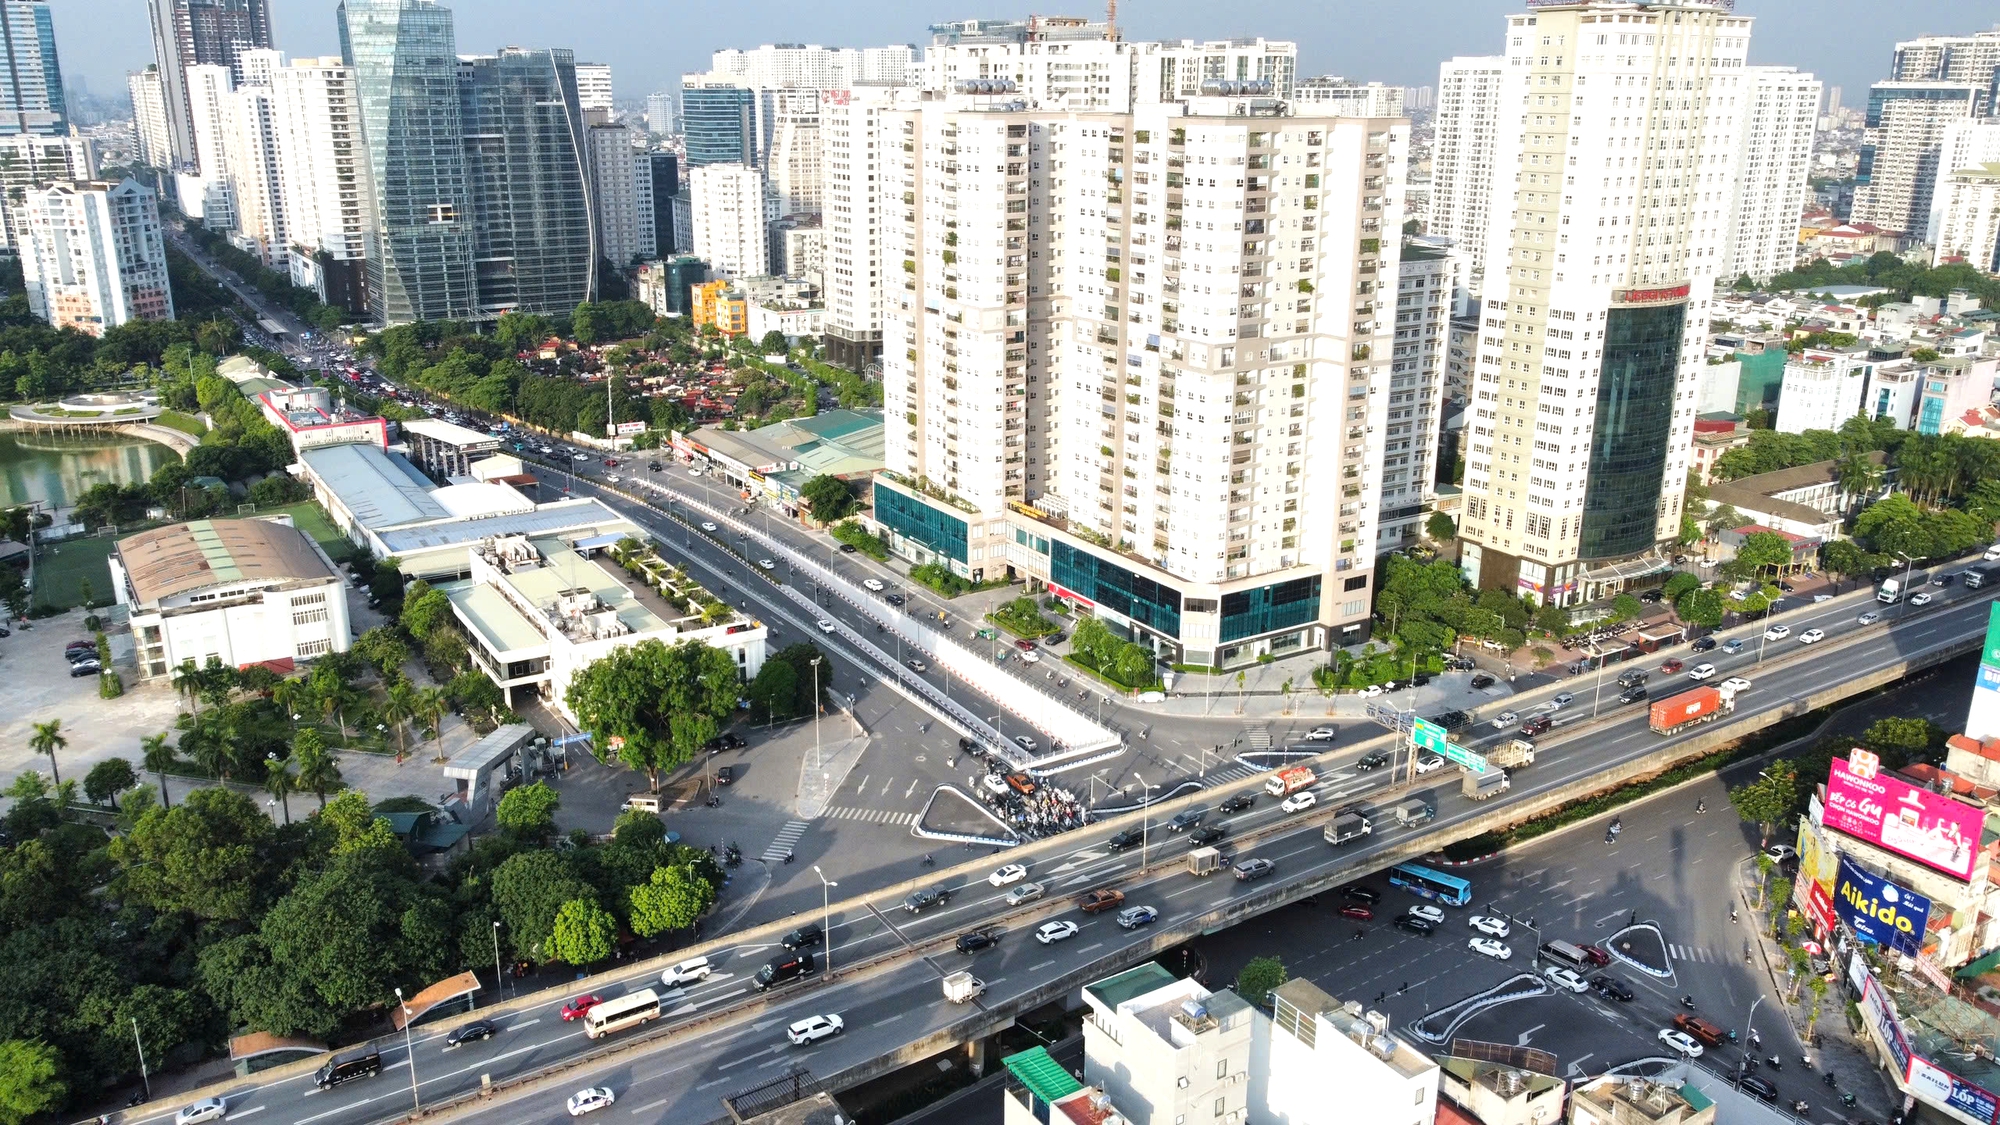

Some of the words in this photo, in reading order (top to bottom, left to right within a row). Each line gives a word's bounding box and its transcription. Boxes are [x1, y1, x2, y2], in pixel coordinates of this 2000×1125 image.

[1834, 769, 1886, 794] HAWONKOO
[1845, 808, 1880, 826] HAWONKOO
[1840, 880, 1912, 933] Aikido
[1951, 1087, 1975, 1105] LỐP
